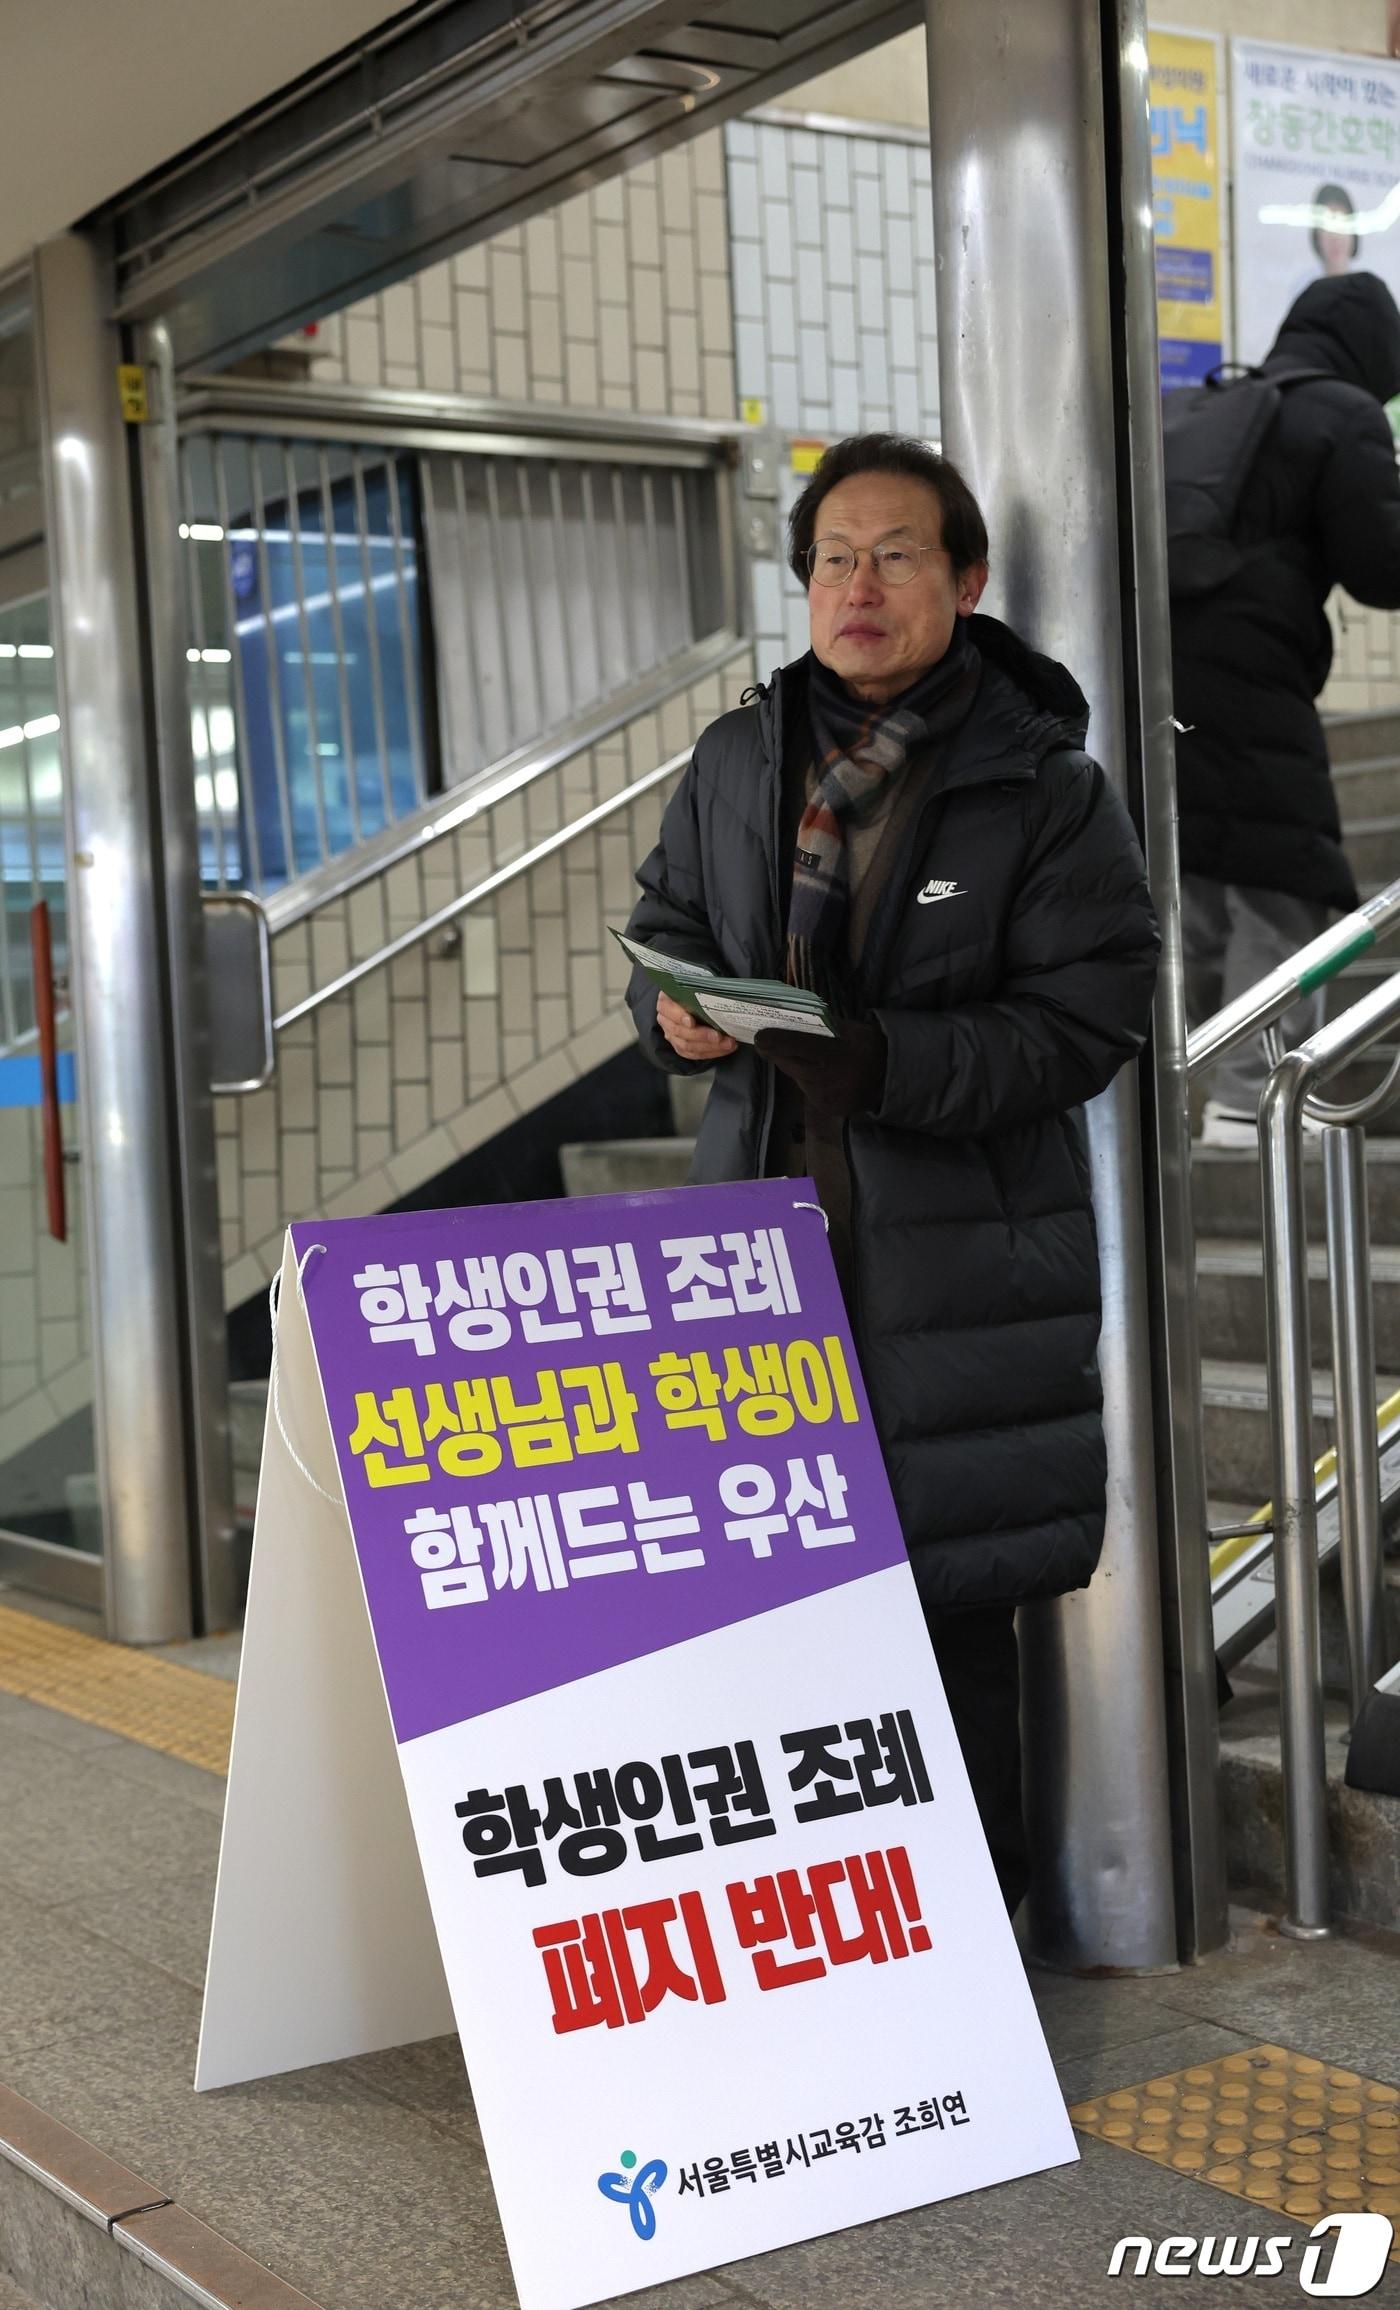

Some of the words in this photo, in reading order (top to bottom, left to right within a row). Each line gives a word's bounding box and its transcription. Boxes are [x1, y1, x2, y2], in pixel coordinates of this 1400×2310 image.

[1248, 97, 1400, 161] 창동간호학
[924, 879, 958, 895] NIKE
[353, 1242, 652, 1357] 학생인권
[660, 1227, 802, 1322] 조례
[349, 1361, 640, 1489] 선생님과
[648, 1335, 860, 1442] 학생이
[403, 1480, 706, 1610] 함께드는
[718, 1453, 857, 1559] 우산
[454, 1739, 777, 1888] 학생인권
[780, 1709, 935, 1824] 조례
[532, 1890, 727, 2035] 폐지
[725, 1846, 933, 1992] 반대!
[677, 2113, 887, 2199] 서울특별시교육감
[893, 2090, 971, 2138] 조희연
